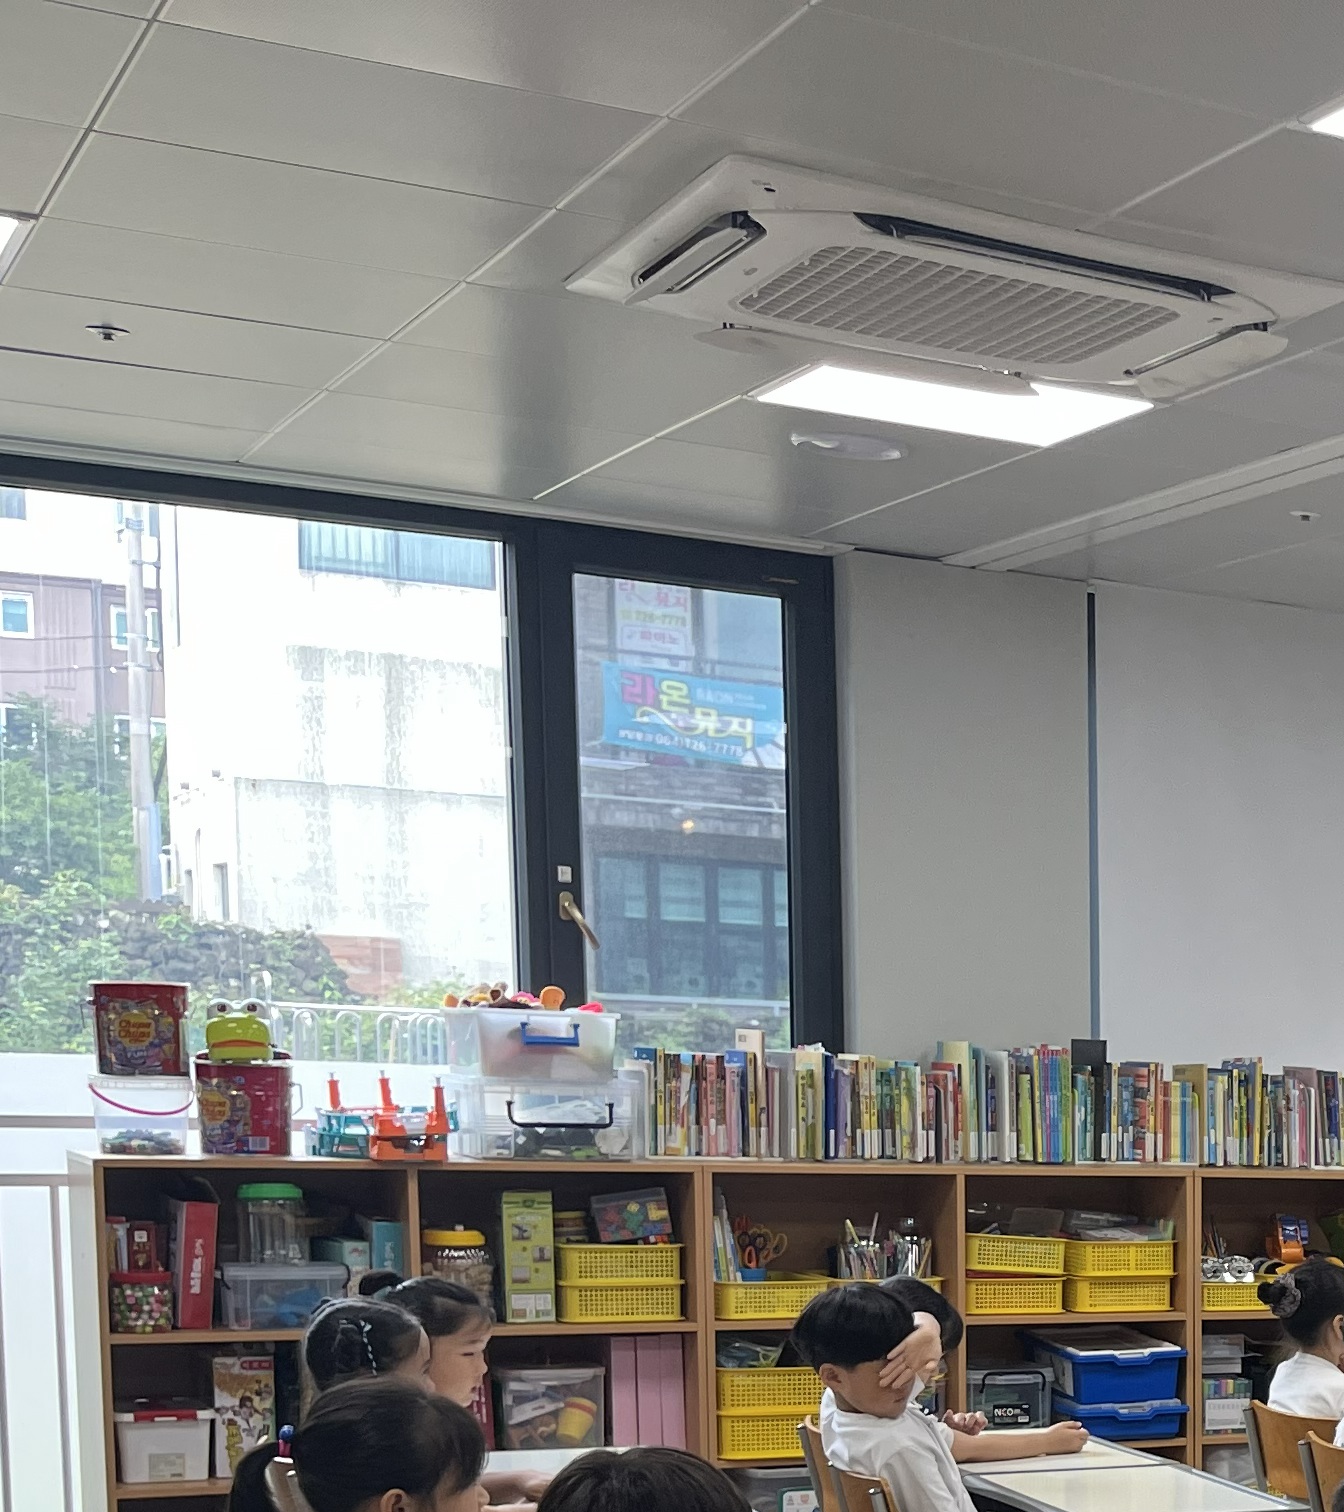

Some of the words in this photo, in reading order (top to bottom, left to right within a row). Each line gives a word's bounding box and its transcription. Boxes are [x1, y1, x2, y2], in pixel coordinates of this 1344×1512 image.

[621, 671, 690, 716] 라온
[693, 707, 752, 749] 뮤직
[118, 1018, 152, 1031] Chupa
[118, 1028, 152, 1040] Chups
